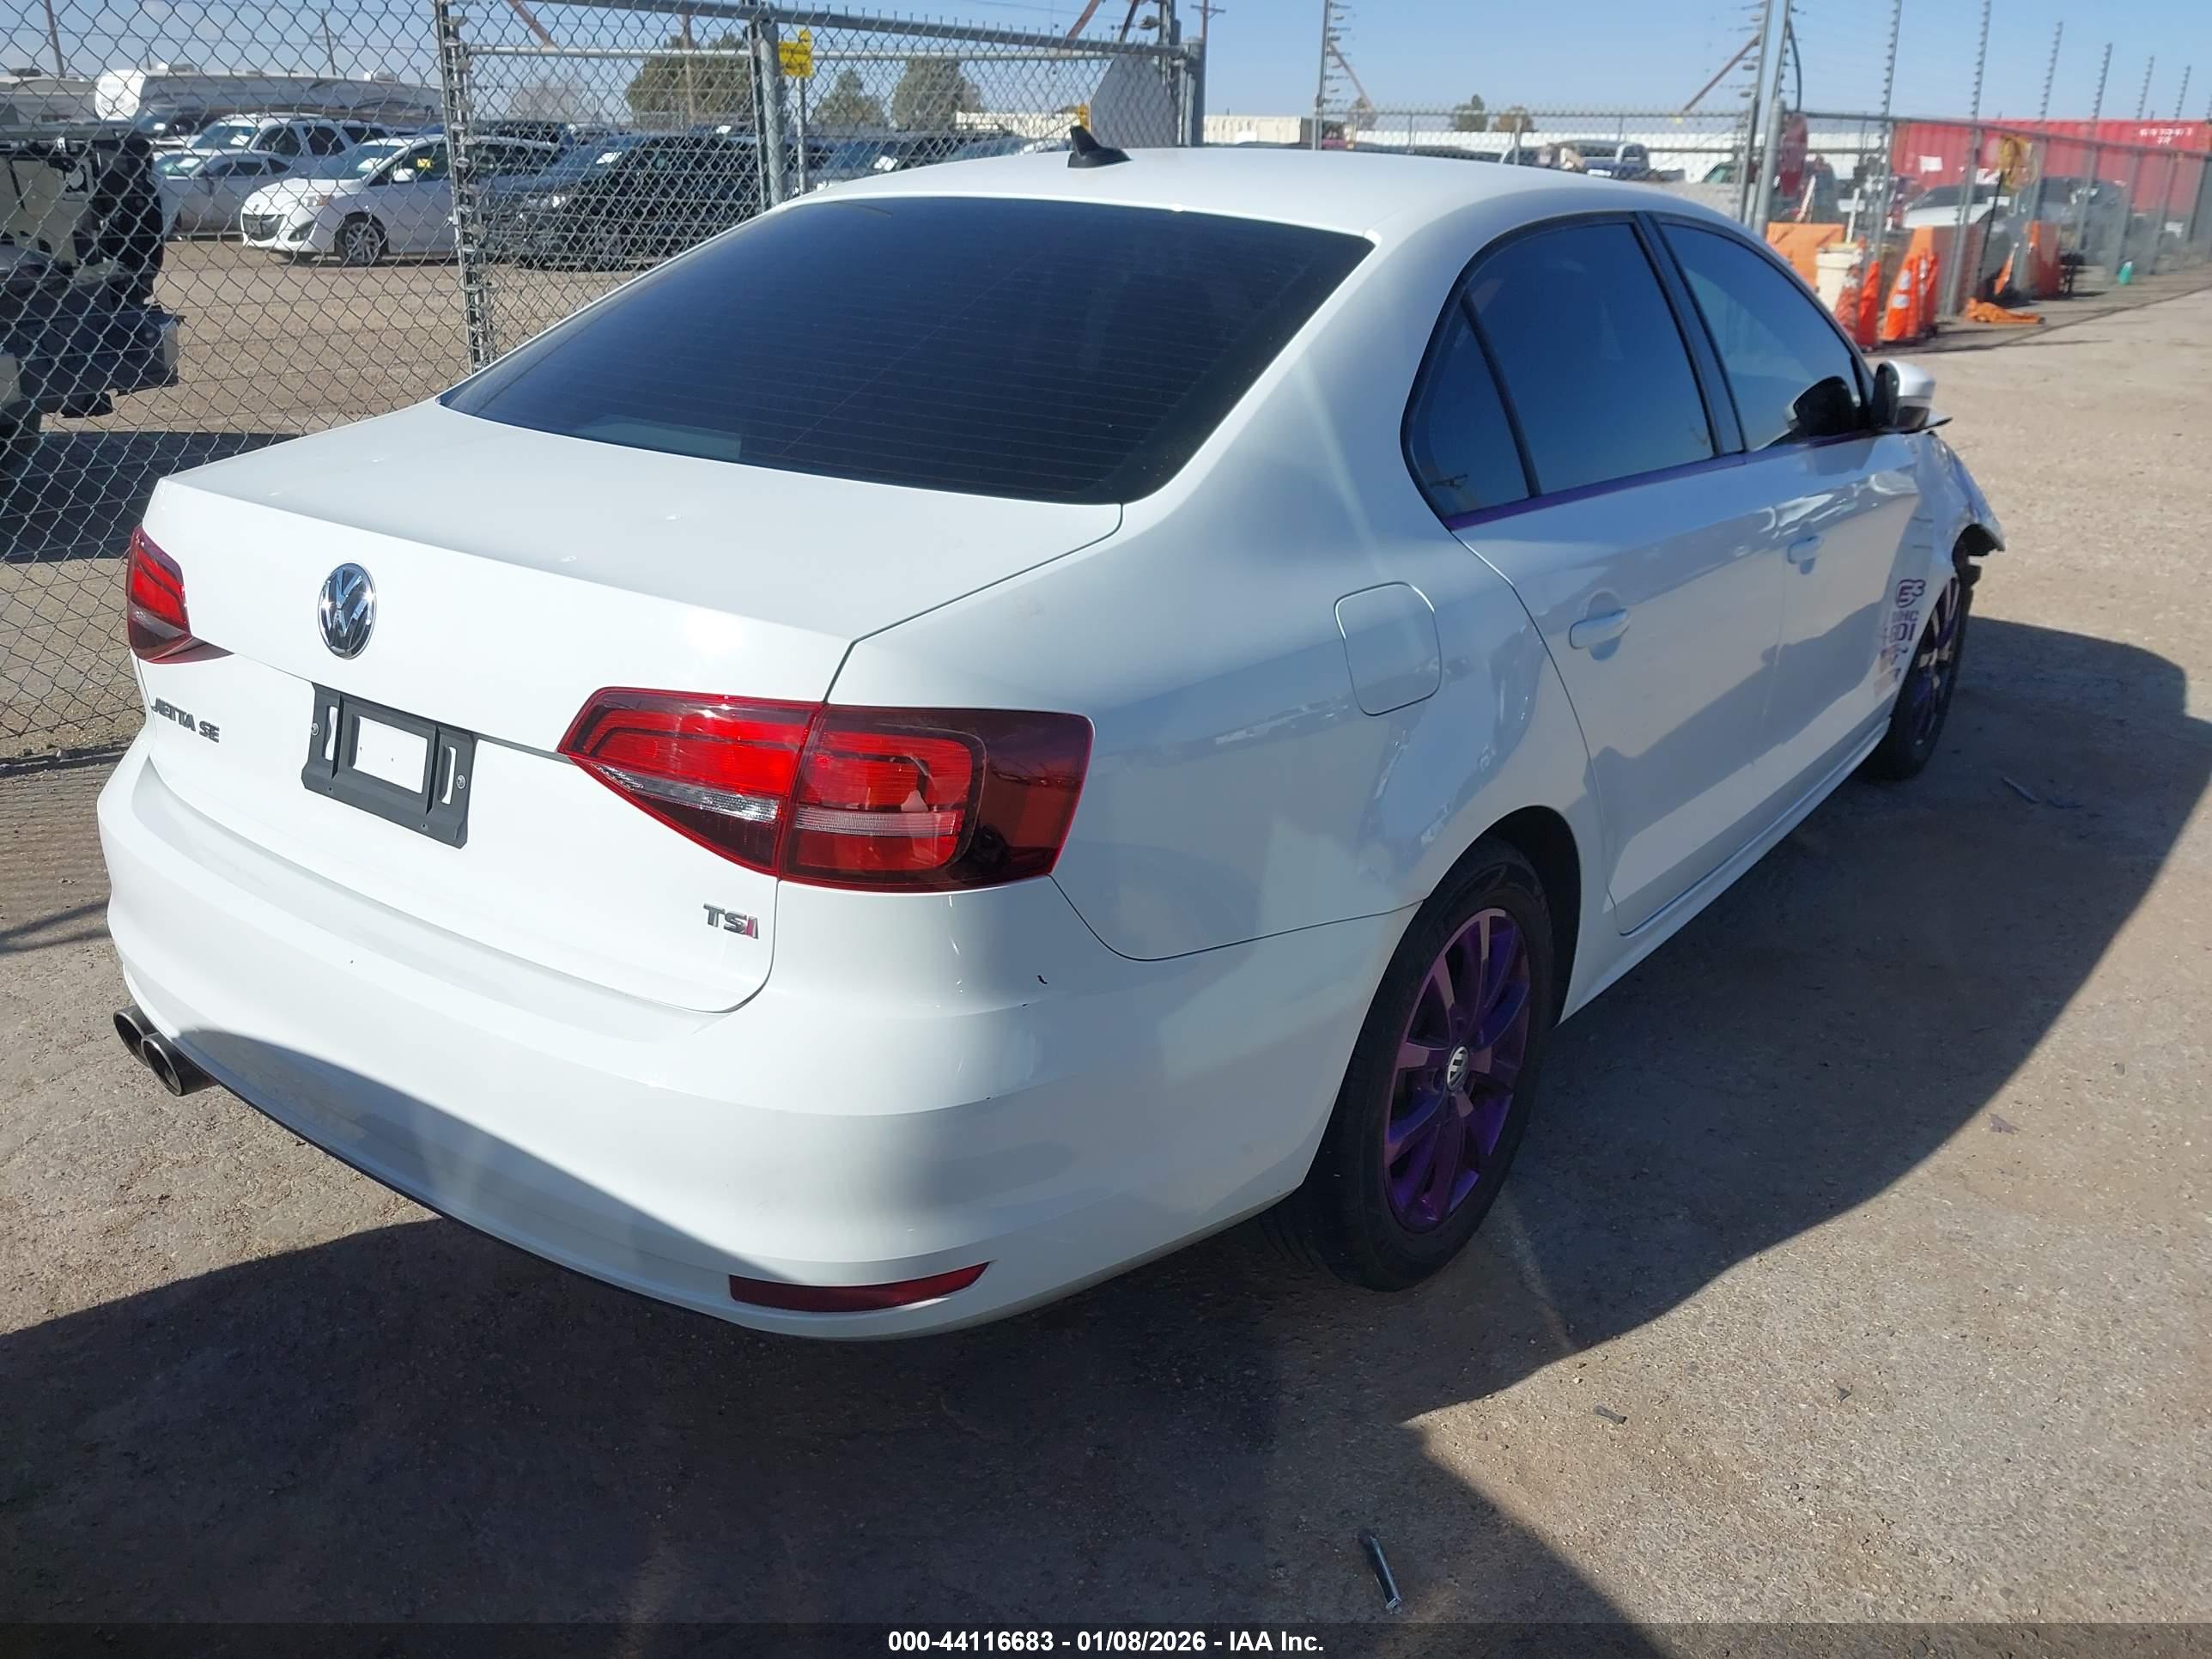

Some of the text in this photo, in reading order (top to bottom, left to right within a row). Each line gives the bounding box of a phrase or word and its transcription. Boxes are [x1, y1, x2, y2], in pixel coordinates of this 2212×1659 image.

[151, 696, 220, 744] JETTA SE
[702, 902, 759, 939] TSI
